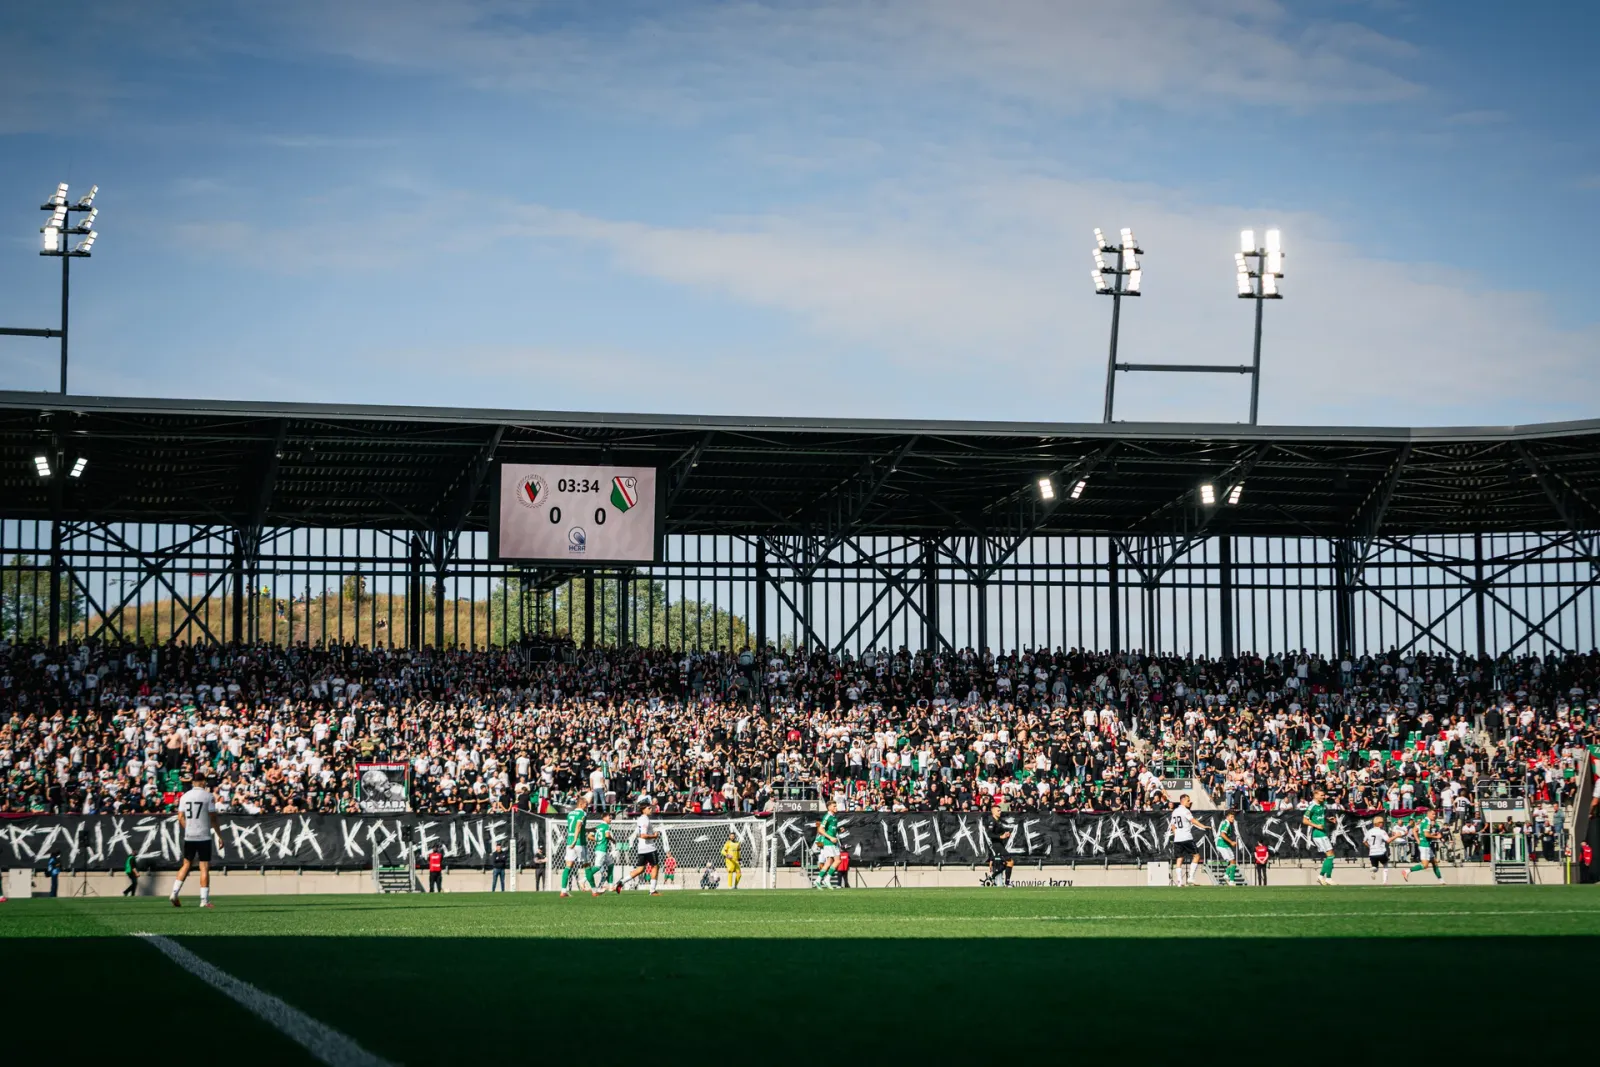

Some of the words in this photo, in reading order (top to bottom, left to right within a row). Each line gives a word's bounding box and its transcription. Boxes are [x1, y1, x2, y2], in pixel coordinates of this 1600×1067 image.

[558, 479, 600, 493] 03:34
[550, 507, 561, 524] 0
[594, 508, 606, 525] 0
[185, 801, 203, 819] 37
[791, 803, 802, 811] 06
[568, 816, 576, 831] 7
[0, 814, 182, 864] RZYJAŹŃ
[1371, 835, 1376, 846] 7
